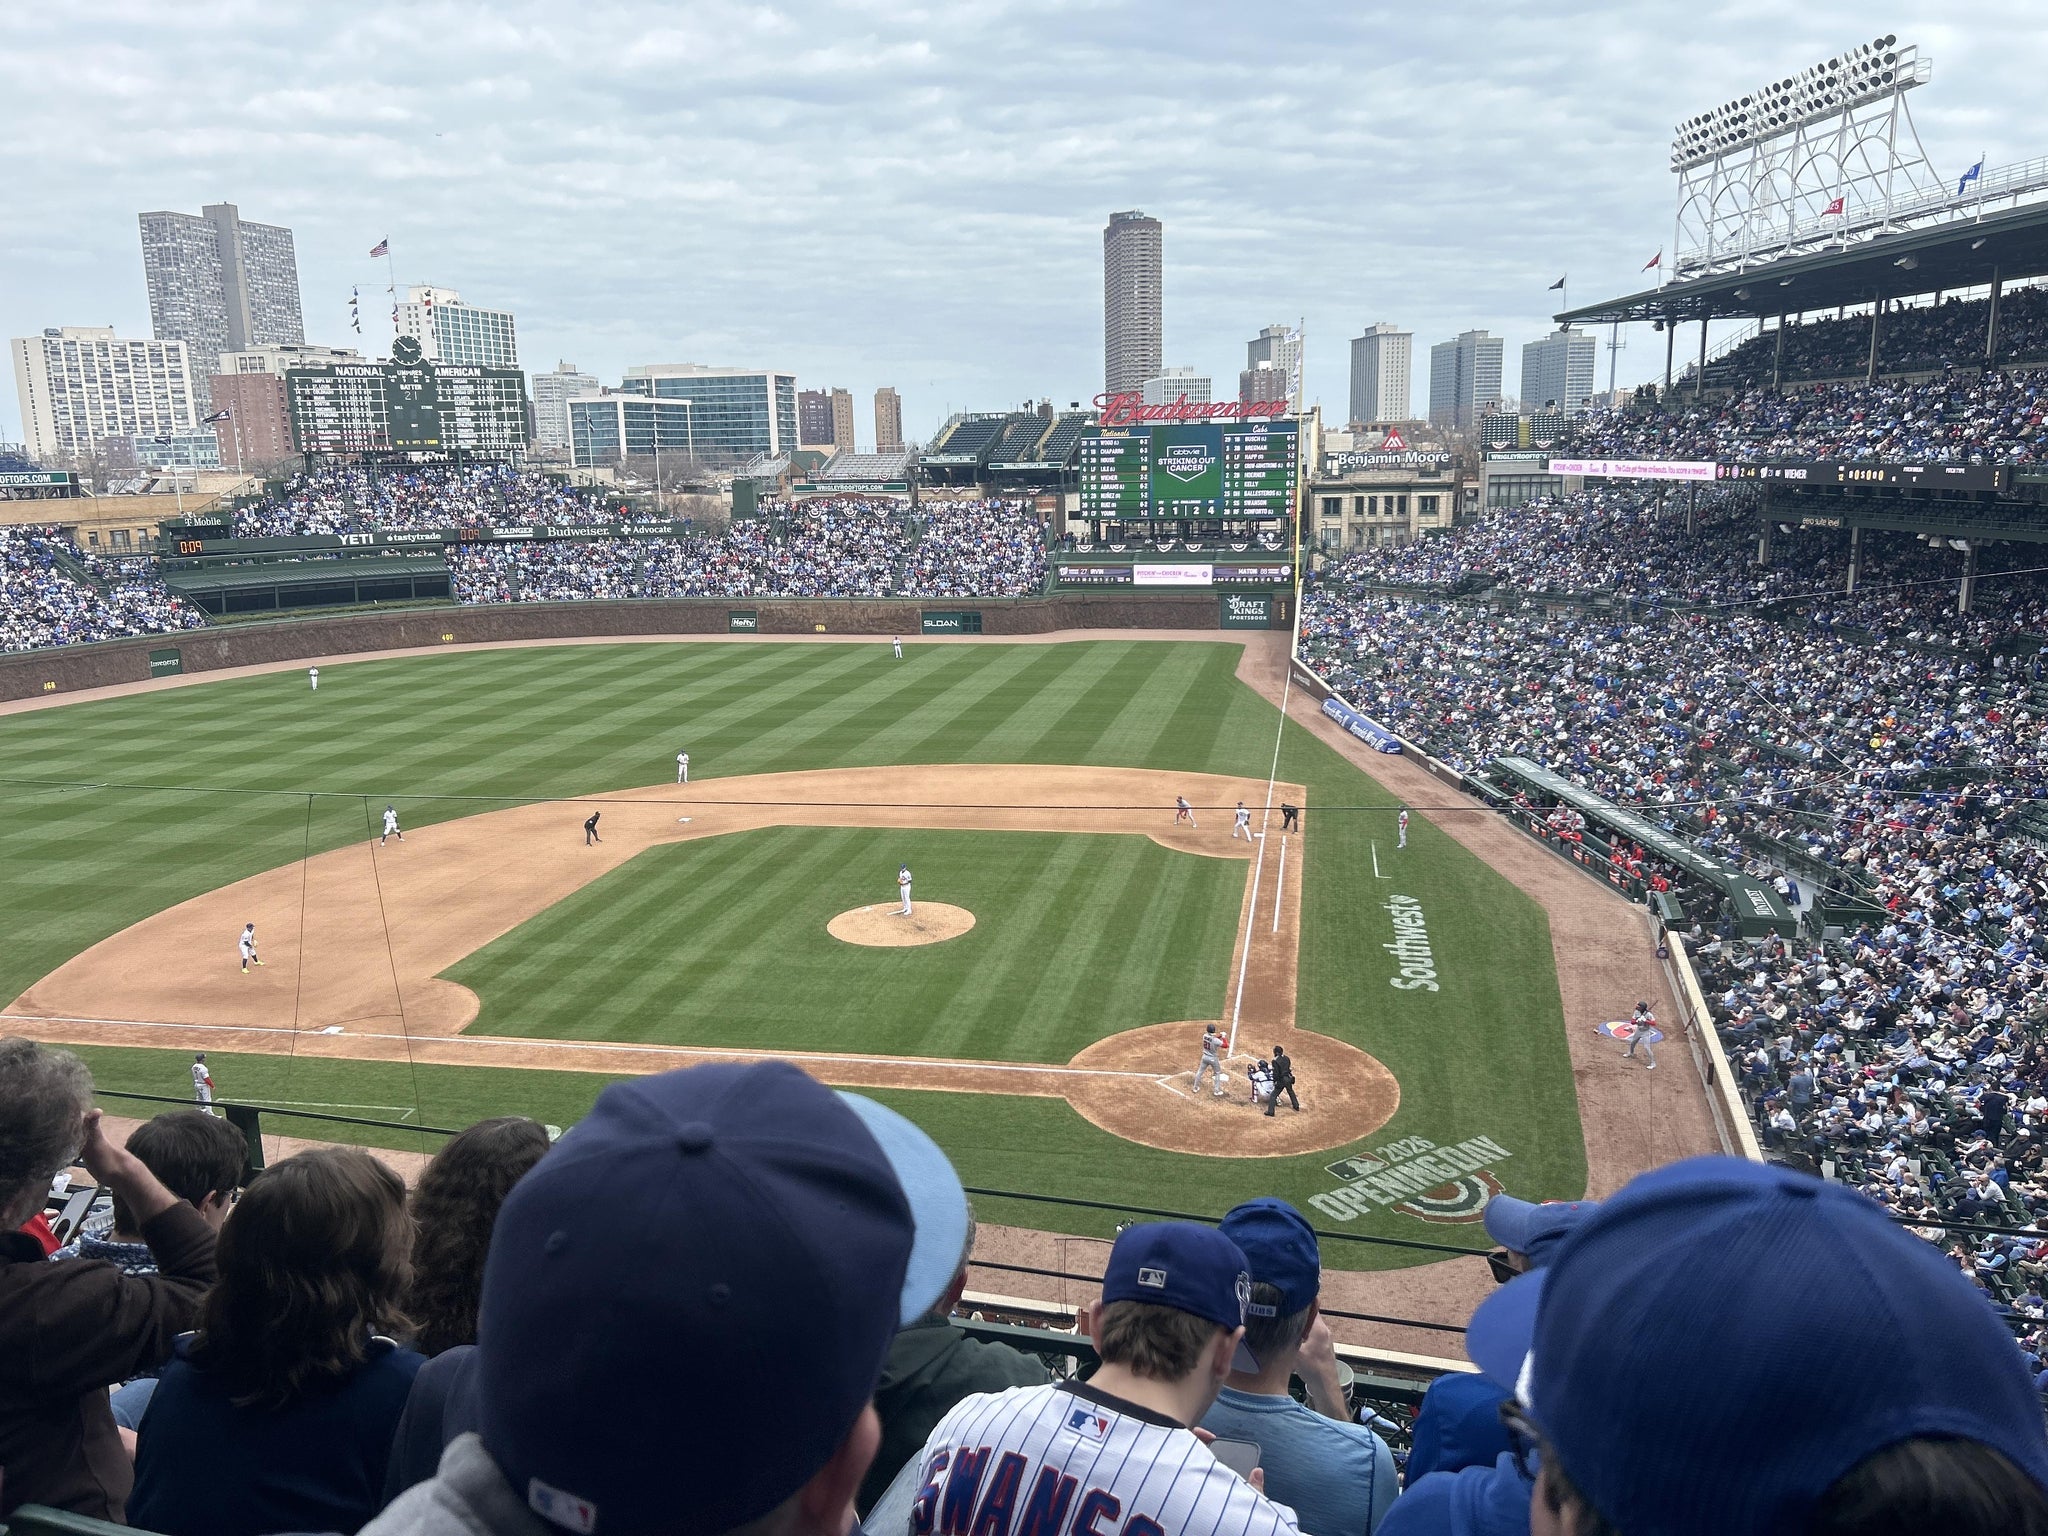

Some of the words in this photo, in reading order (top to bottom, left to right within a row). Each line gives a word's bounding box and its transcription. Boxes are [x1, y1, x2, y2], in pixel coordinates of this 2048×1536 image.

[335, 367, 385, 376] NATIONAL
[435, 367, 481, 377] AMERICAN
[405, 391, 417, 400] 21
[1093, 391, 1289, 425] Budweiser
[1100, 428, 1130, 437] Nationals
[1252, 424, 1268, 433] Cubs
[1158, 457, 1198, 465] STRIKING
[1338, 452, 1400, 466] Benjamin
[1404, 451, 1449, 464] Moore
[1170, 464, 1203, 472] CANCER
[1158, 506, 1164, 515] 2
[1173, 506, 1178, 515] 1
[1208, 505, 1214, 515] 4
[493, 527, 534, 535] GRAINGER
[632, 525, 672, 534] Advocate
[338, 533, 374, 545] YETI
[393, 532, 442, 544] tastytrade
[180, 541, 203, 553] 0:09
[1229, 601, 1265, 609] DRAFT
[732, 618, 754, 628] Hefty
[150, 658, 179, 668] Invenergy
[1383, 901, 1440, 992] Southwest
[1376, 1135, 1437, 1163] 2026
[1251, 1305, 1274, 1316] UBS
[913, 1446, 1166, 1536] SWANS
